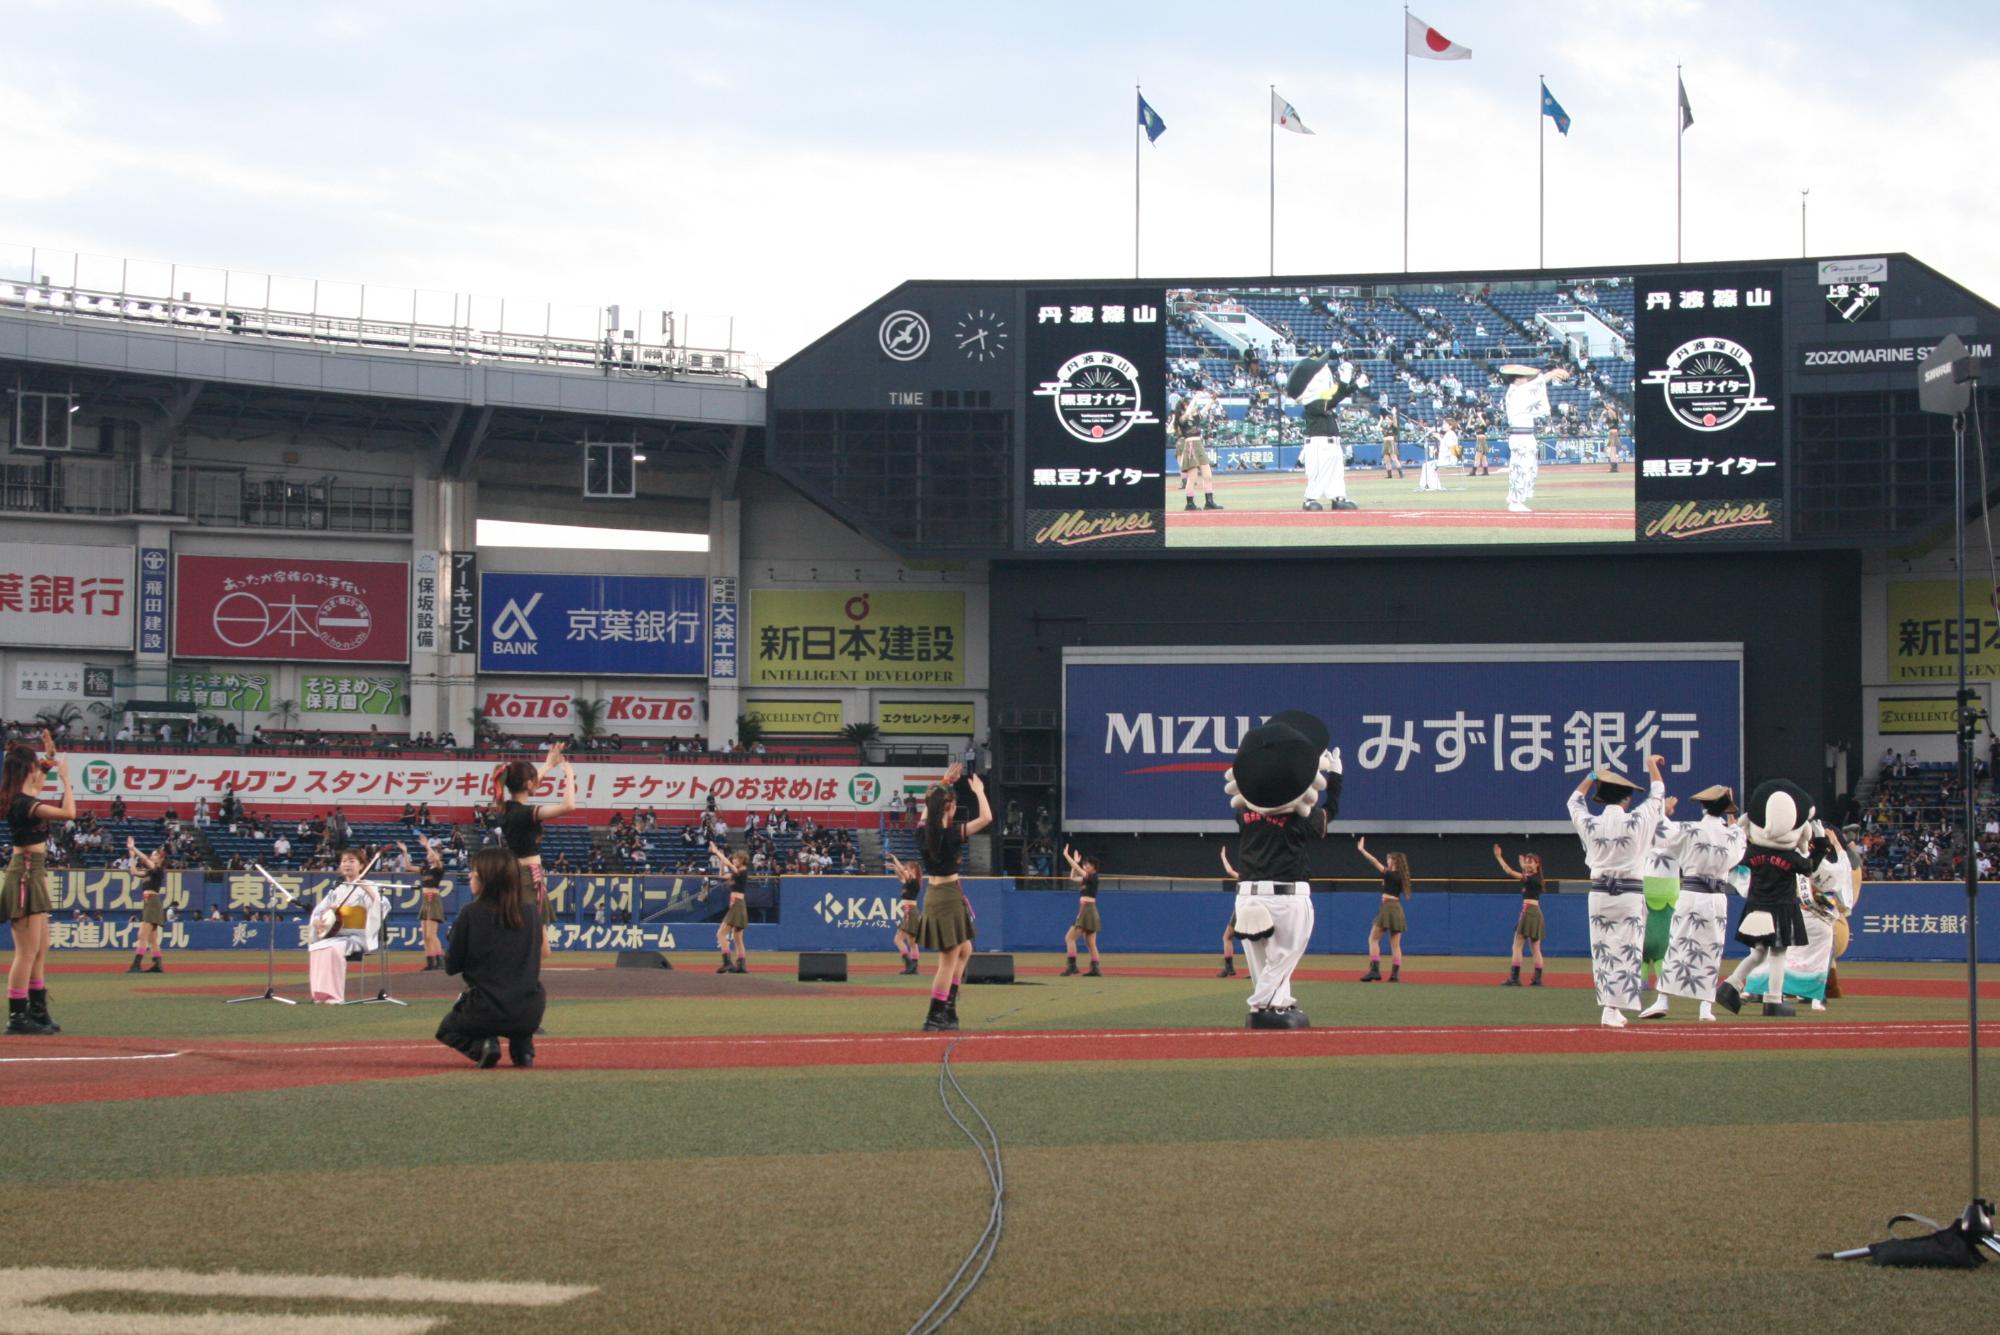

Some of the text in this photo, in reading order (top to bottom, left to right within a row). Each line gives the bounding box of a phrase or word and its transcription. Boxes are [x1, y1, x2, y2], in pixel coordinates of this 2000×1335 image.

[1646, 288, 1771, 310] 丹波篠山
[1038, 305, 1157, 323] 丹波篠山
[1805, 347, 1914, 366] ZOZOMARINE
[1669, 380, 1750, 394] 黒豆ナイター
[889, 392, 923, 406] TIME
[1060, 393, 1136, 406] 黒豆ナイター
[1033, 468, 1160, 486] 黒豆ナイター
[1642, 457, 1777, 477] 黒豆ナイター
[1035, 509, 1155, 544] Marines
[1644, 501, 1771, 538] Marines
[416, 577, 434, 648] 保坂設備
[452, 554, 474, 650] アーキセプト
[143, 580, 163, 649] 飛田建設
[566, 609, 700, 644] 京葉銀行
[492, 641, 538, 655] BANK
[712, 605, 736, 676] 大森工業
[760, 625, 954, 662] 新日本建設
[306, 678, 370, 694] そらまめ
[761, 669, 953, 682] INTELLIGENT DEVELOPER
[306, 693, 357, 710] 保育園
[812, 711, 840, 724] CITY
[882, 713, 970, 725] エクセレントシティ
[1105, 712, 1273, 755] MIZU
[1357, 709, 1700, 774] みずほ銀行
[612, 775, 839, 801] チケットのお求めは
[564, 924, 676, 949] アインズホーム
